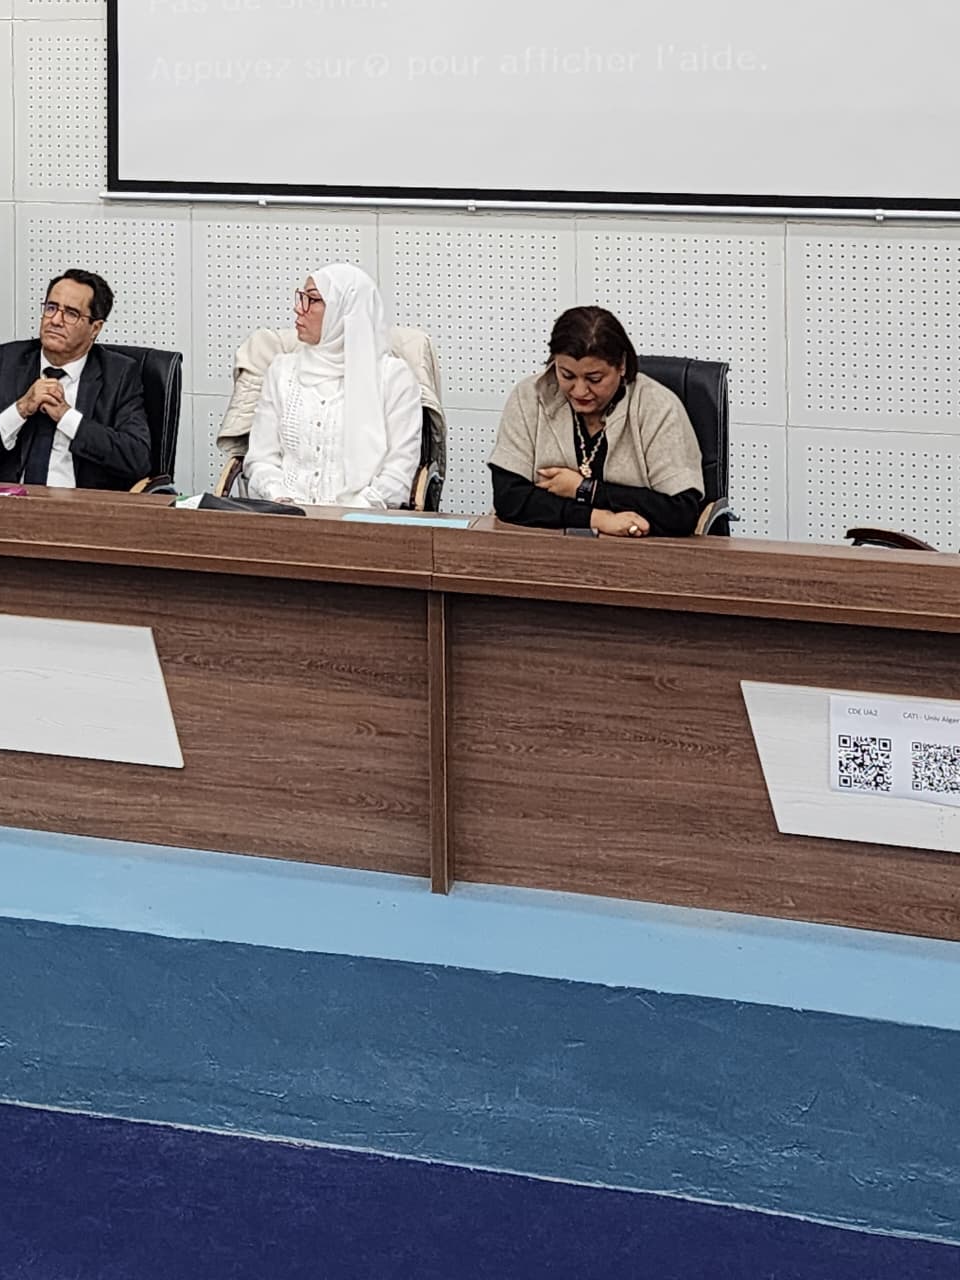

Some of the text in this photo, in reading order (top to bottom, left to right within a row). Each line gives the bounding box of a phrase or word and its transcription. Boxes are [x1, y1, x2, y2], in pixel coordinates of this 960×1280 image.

[149, 54, 291, 86] Appuyez
[407, 52, 485, 80] pour
[499, 45, 639, 75] afficher
[655, 40, 768, 72] l'aide.
